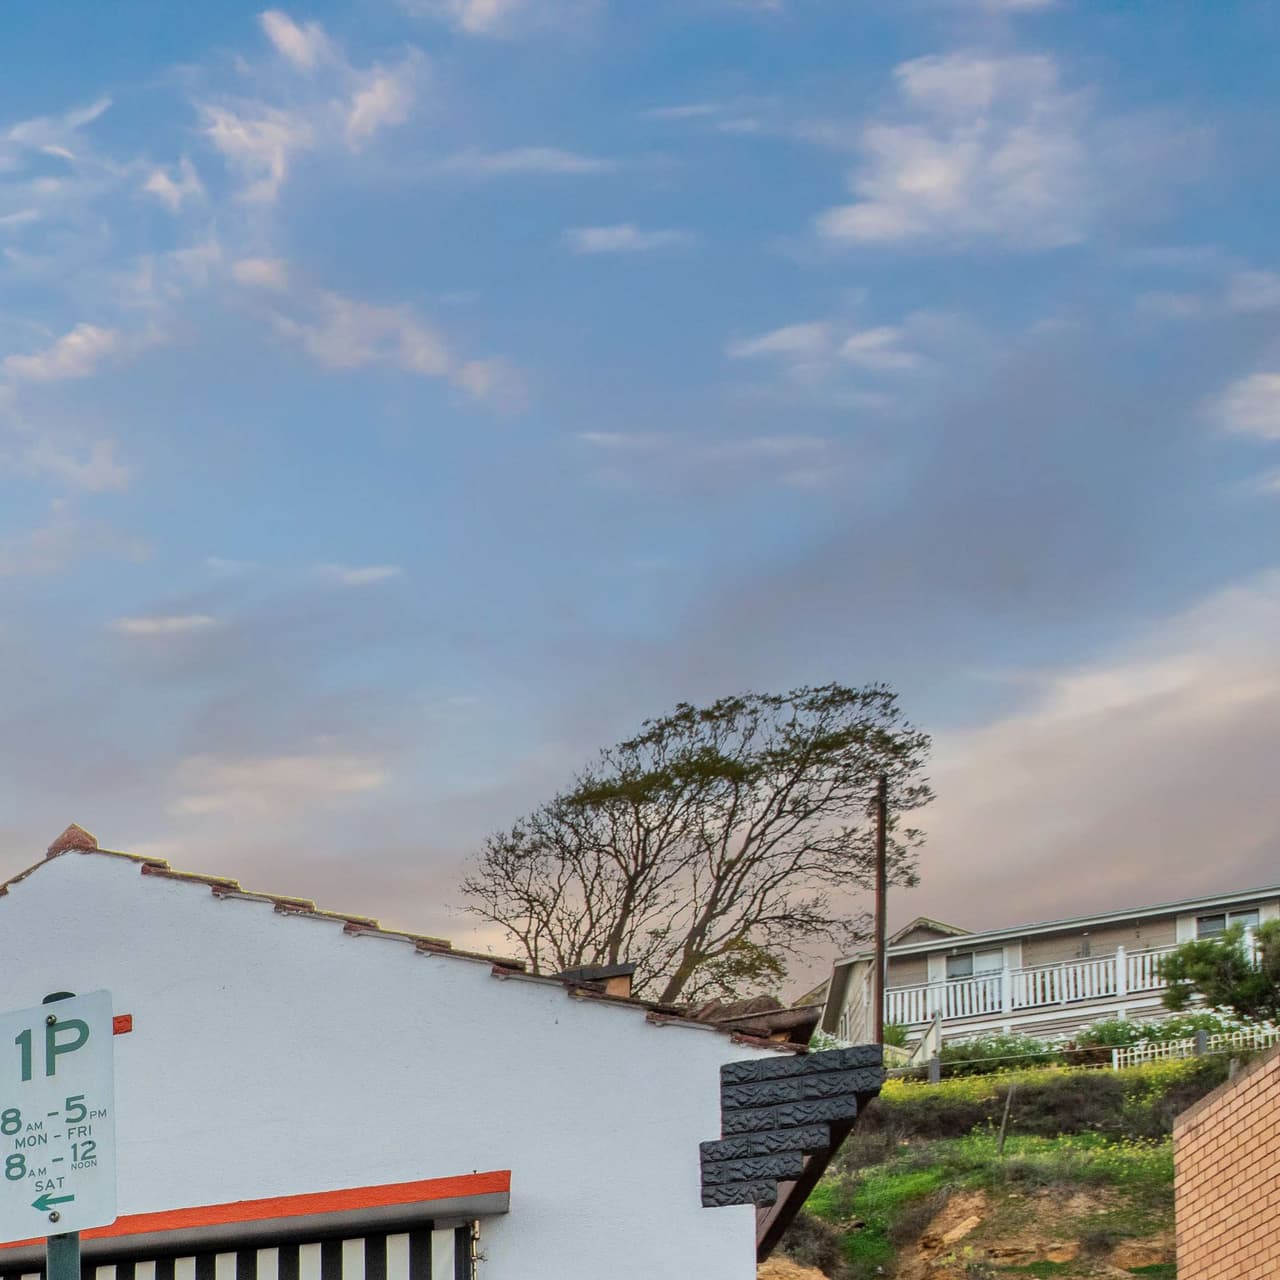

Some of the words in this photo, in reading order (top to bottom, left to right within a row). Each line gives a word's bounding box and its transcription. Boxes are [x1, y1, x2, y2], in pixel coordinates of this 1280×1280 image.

[15, 1018, 90, 1081] 1P
[15, 1133, 47, 1149] MON
[68, 1125, 91, 1140] FRI
[71, 1140, 96, 1162] 12
[71, 1160, 97, 1170] NOON
[35, 1177, 64, 1192] SAT
